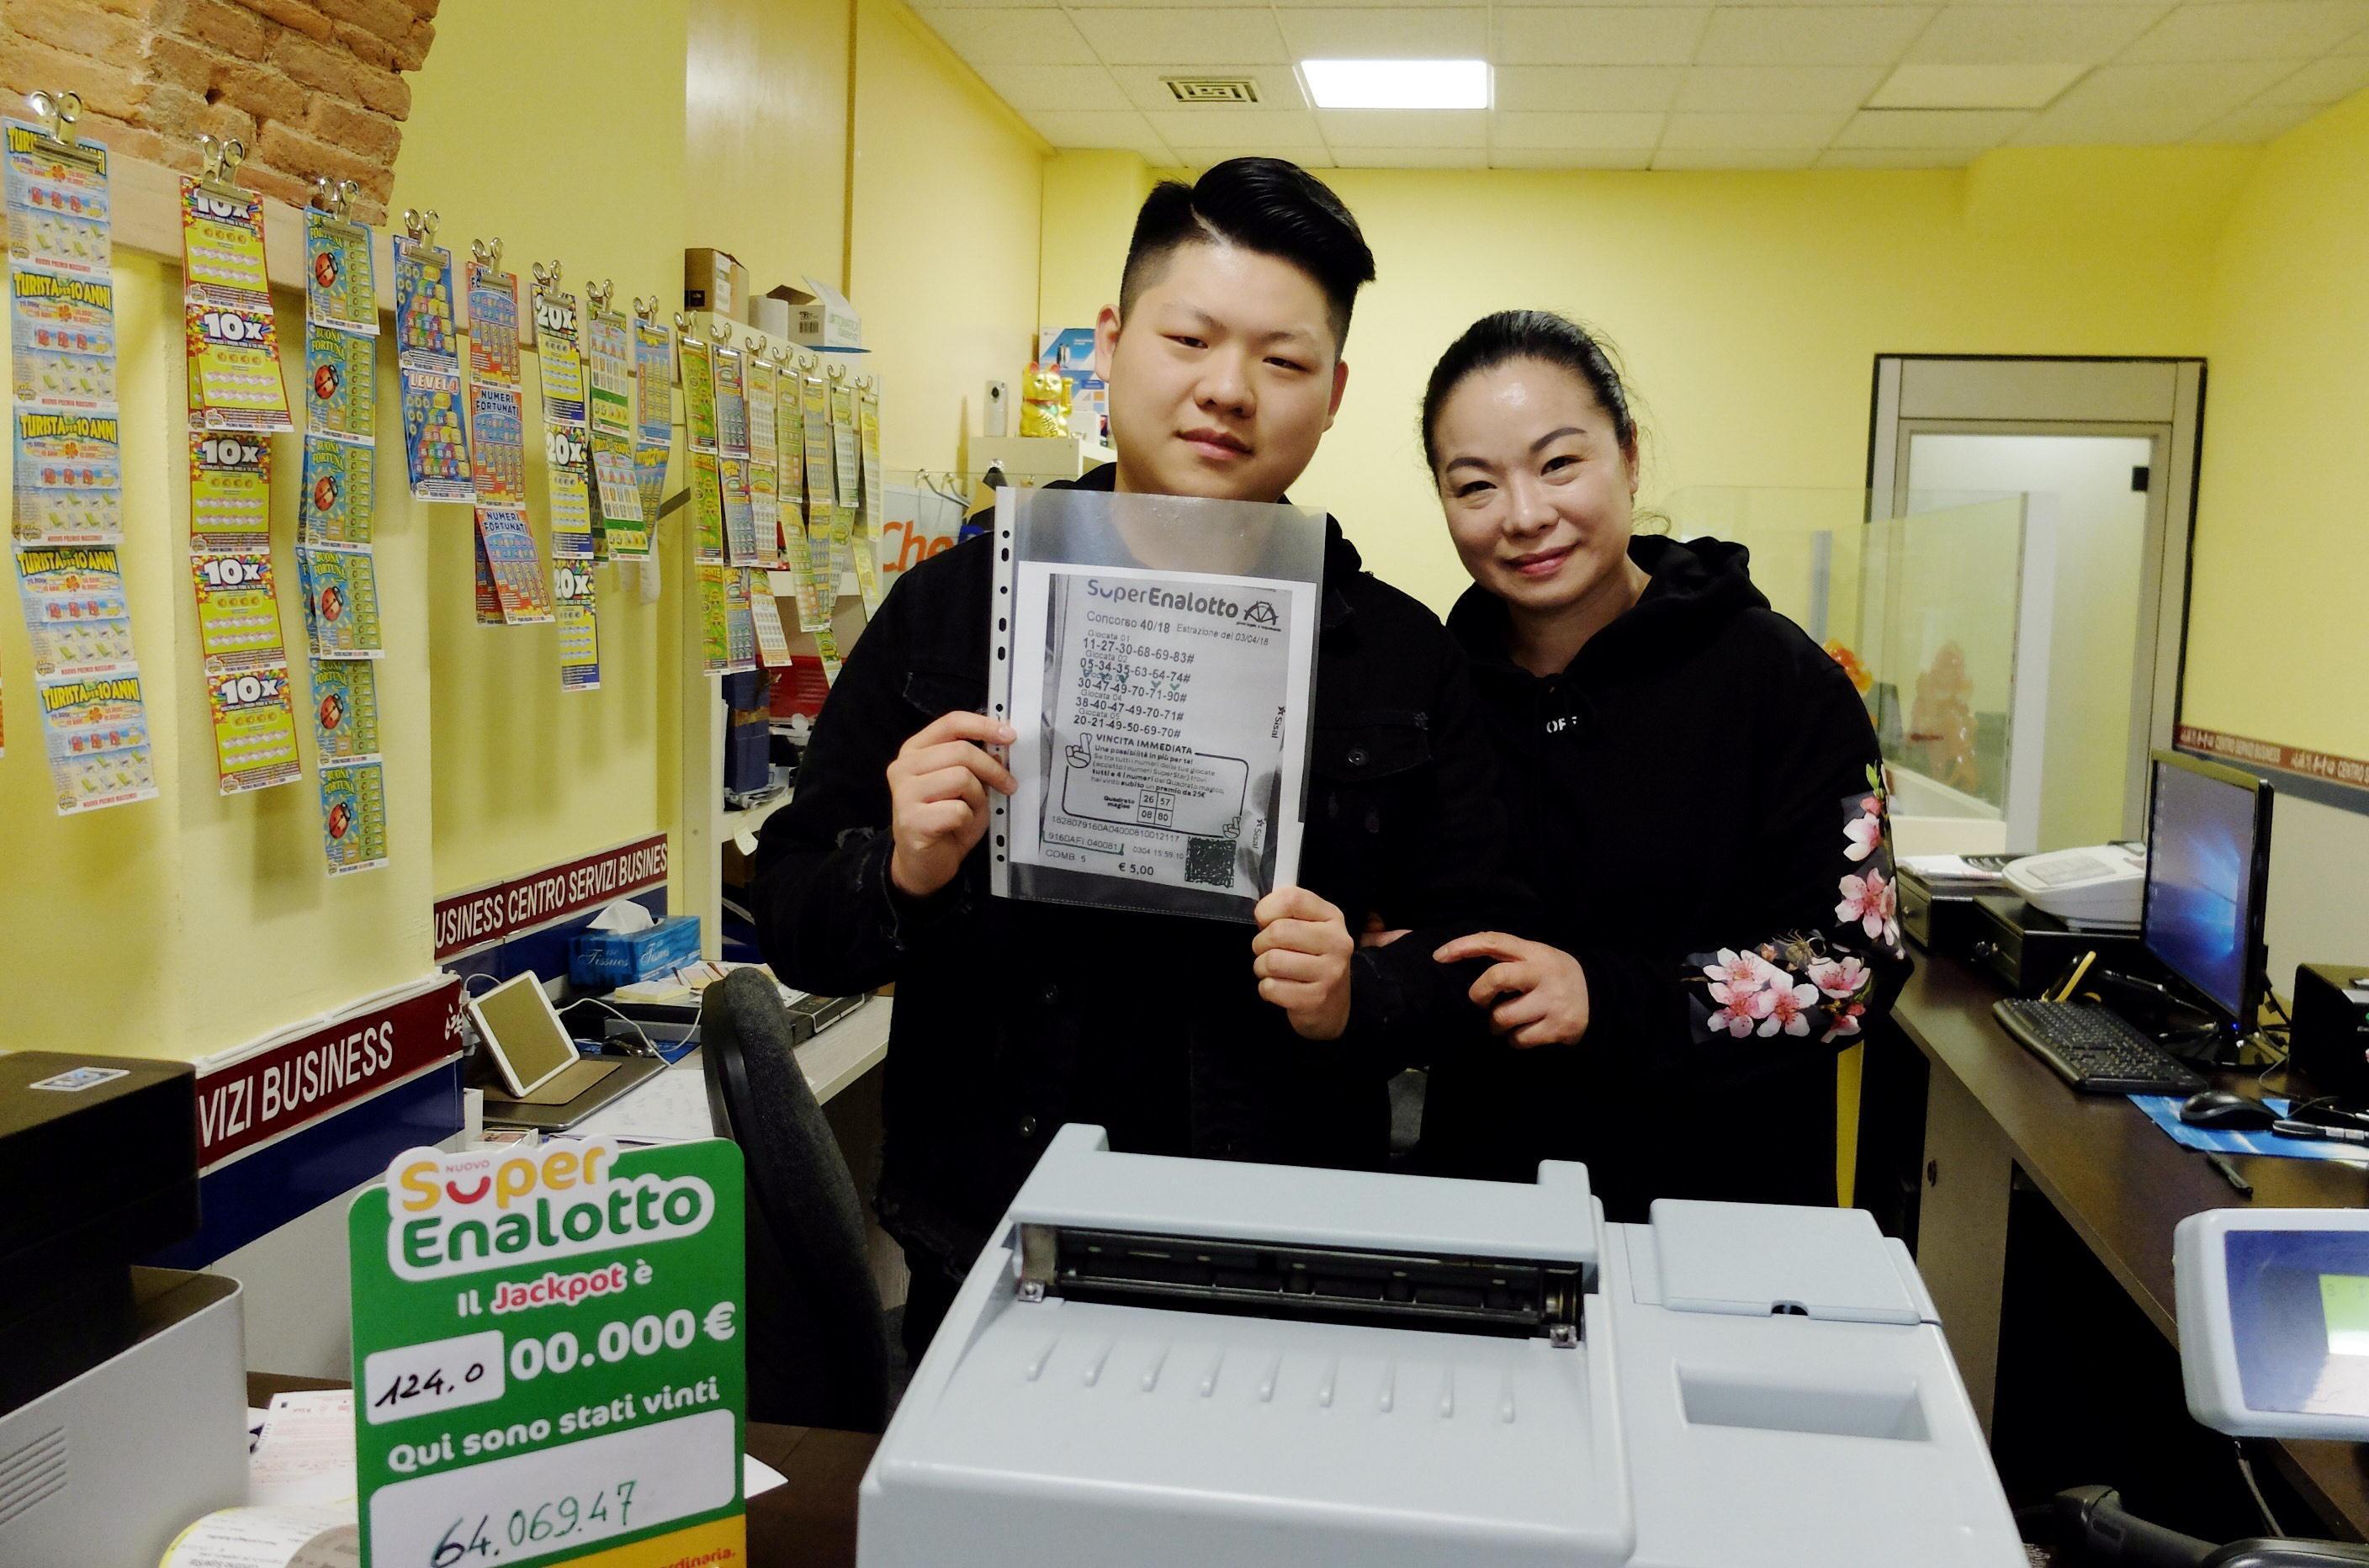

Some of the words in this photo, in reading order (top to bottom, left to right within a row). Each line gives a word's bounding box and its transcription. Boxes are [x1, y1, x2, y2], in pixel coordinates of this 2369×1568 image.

[13, 273, 60, 298] TURISTA
[69, 281, 82, 301] 10
[84, 282, 112, 311] ANNI
[409, 372, 448, 391] LEVEL
[481, 389, 513, 404] NUMERI
[476, 400, 518, 418] FORTUNATI
[19, 413, 66, 439] TURISTA
[77, 417, 90, 437] 10
[90, 418, 118, 444] ANNI
[485, 522, 527, 533] FORTUNATI
[486, 511, 519, 522] NUMERI
[17, 550, 64, 577] TURISTA
[73, 551, 87, 569] 10
[87, 550, 119, 574] ANNI
[1088, 579, 1238, 618] SuperEnalotto
[1087, 611, 1137, 628] Concorso
[1140, 619, 1170, 633] 40/18
[1177, 623, 1218, 638] Estrazione
[1221, 631, 1233, 641] del
[1235, 633, 1269, 646] 03/04/18
[1088, 629, 1117, 641] Giocata
[1083, 638, 1195, 665] 11-27-30-68-69-83#
[1085, 649, 1115, 661] Giocata
[1080, 658, 1190, 683] 05-34-35-63-64-74#
[42, 683, 88, 713] TURISTA
[97, 681, 111, 700] 10
[111, 678, 141, 702] ANNI
[1078, 677, 1188, 702] 30-47-49-70-71-90#
[1081, 689, 1110, 701] Giocata
[1075, 697, 1184, 721] 38-40-47-49-70-71#
[1079, 707, 1108, 718] Giocata
[1073, 715, 1181, 739] 20-21-49-50-69-70#
[1271, 716, 1283, 739] Sisal
[1096, 734, 1134, 746] VINCITA
[1137, 739, 1192, 755] IMMEDIATA
[1143, 795, 1154, 803] 26
[1160, 797, 1171, 806] 57
[1156, 785, 1181, 794] premio
[1142, 810, 1152, 818] 08
[1252, 827, 1262, 849] Sisal
[1119, 862, 1126, 871] €
[1130, 864, 1154, 877] 5,00
[507, 874, 566, 924] CENTRO
[568, 858, 617, 903] SERVIZI
[199, 1075, 253, 1148] VIZI
[261, 1020, 394, 1122] BUSINESS
[445, 1159, 490, 1173] NUOVO
[400, 1146, 607, 1212] Super
[402, 1184, 702, 1269] Enalotto
[457, 1290, 482, 1317] Il
[494, 1264, 625, 1312] Jackpot
[633, 1258, 654, 1285] è
[510, 1309, 696, 1381] 00.000
[702, 1301, 736, 1341] €
[387, 1433, 454, 1473] Qui
[463, 1419, 552, 1456] sono
[559, 1393, 637, 1434] stati
[642, 1375, 721, 1414] vinti
